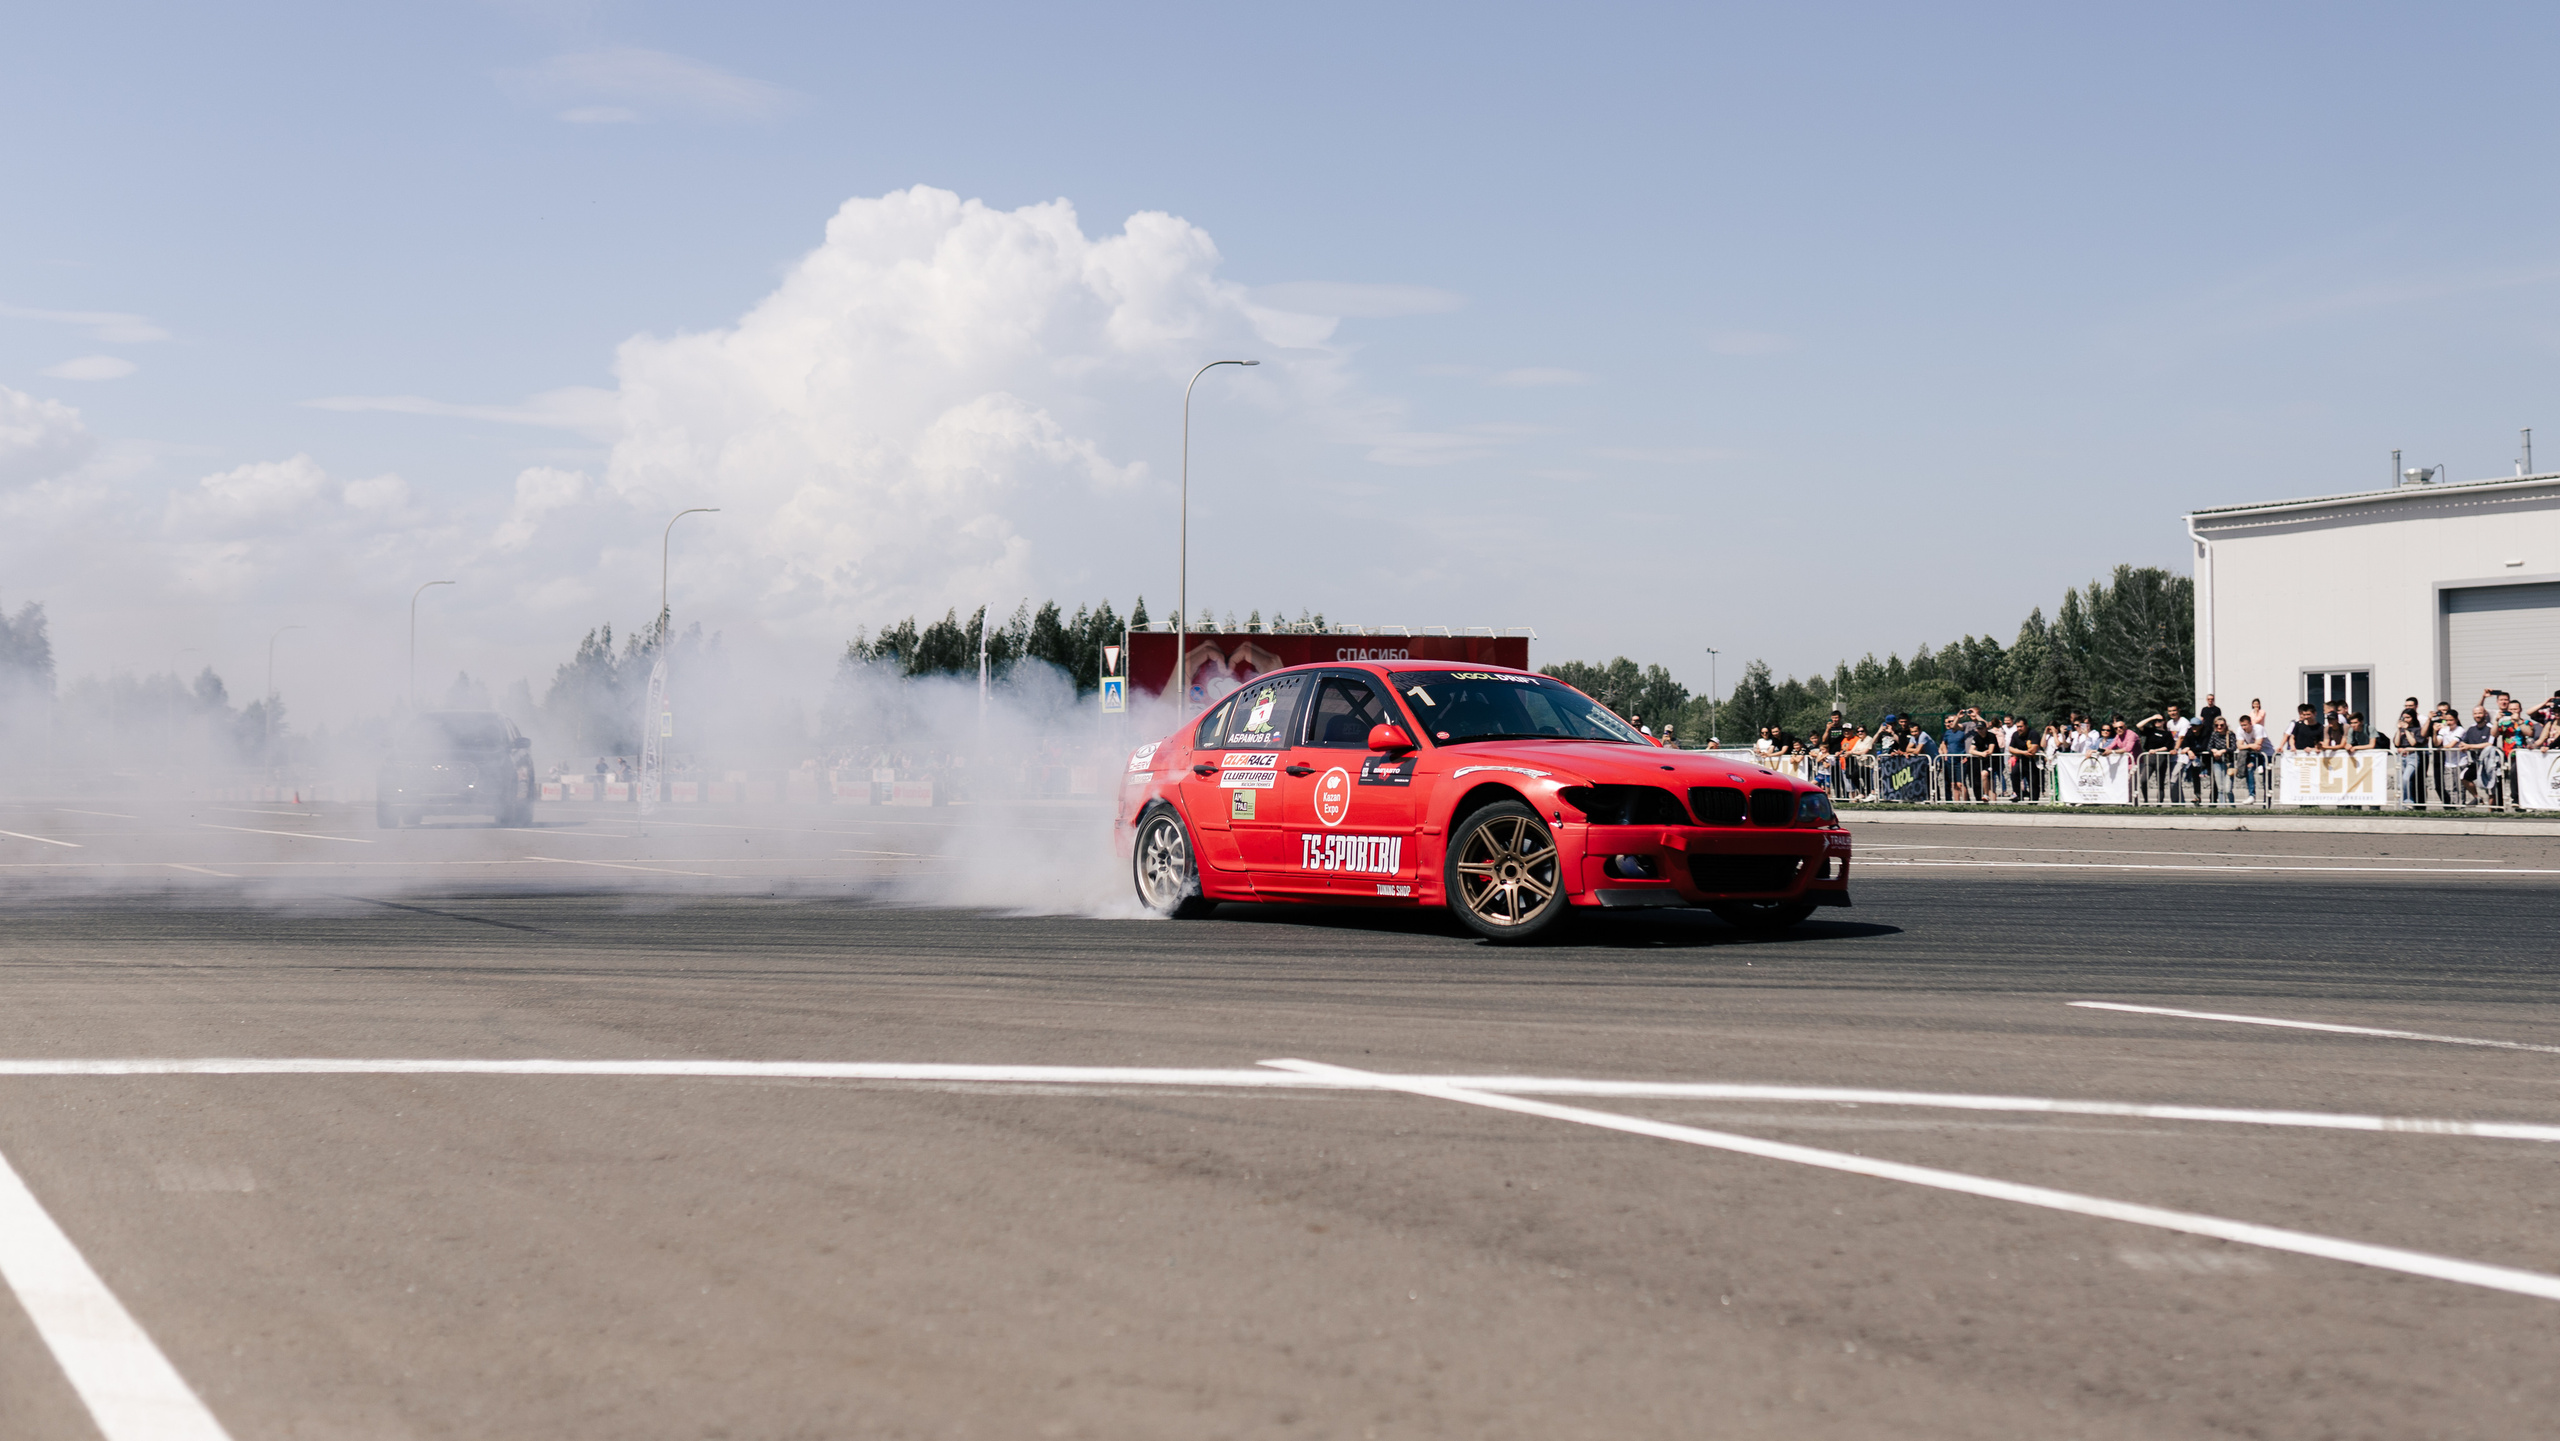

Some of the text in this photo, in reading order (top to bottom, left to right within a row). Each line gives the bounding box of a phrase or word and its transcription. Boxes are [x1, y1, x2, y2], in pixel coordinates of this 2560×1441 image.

[1336, 648, 1409, 661] СПАСИБО
[1407, 686, 1436, 706] 1
[1215, 701, 1232, 737] 1
[1259, 710, 1265, 719] 1
[1228, 734, 1263, 743] АБРАМОВ
[1223, 772, 1275, 781] CLUBTURBO
[2294, 756, 2373, 793] ТСИ
[1323, 793, 1341, 802] Kazan
[1324, 804, 1339, 815] Expo
[1377, 884, 1411, 897] TUNING SHOP
